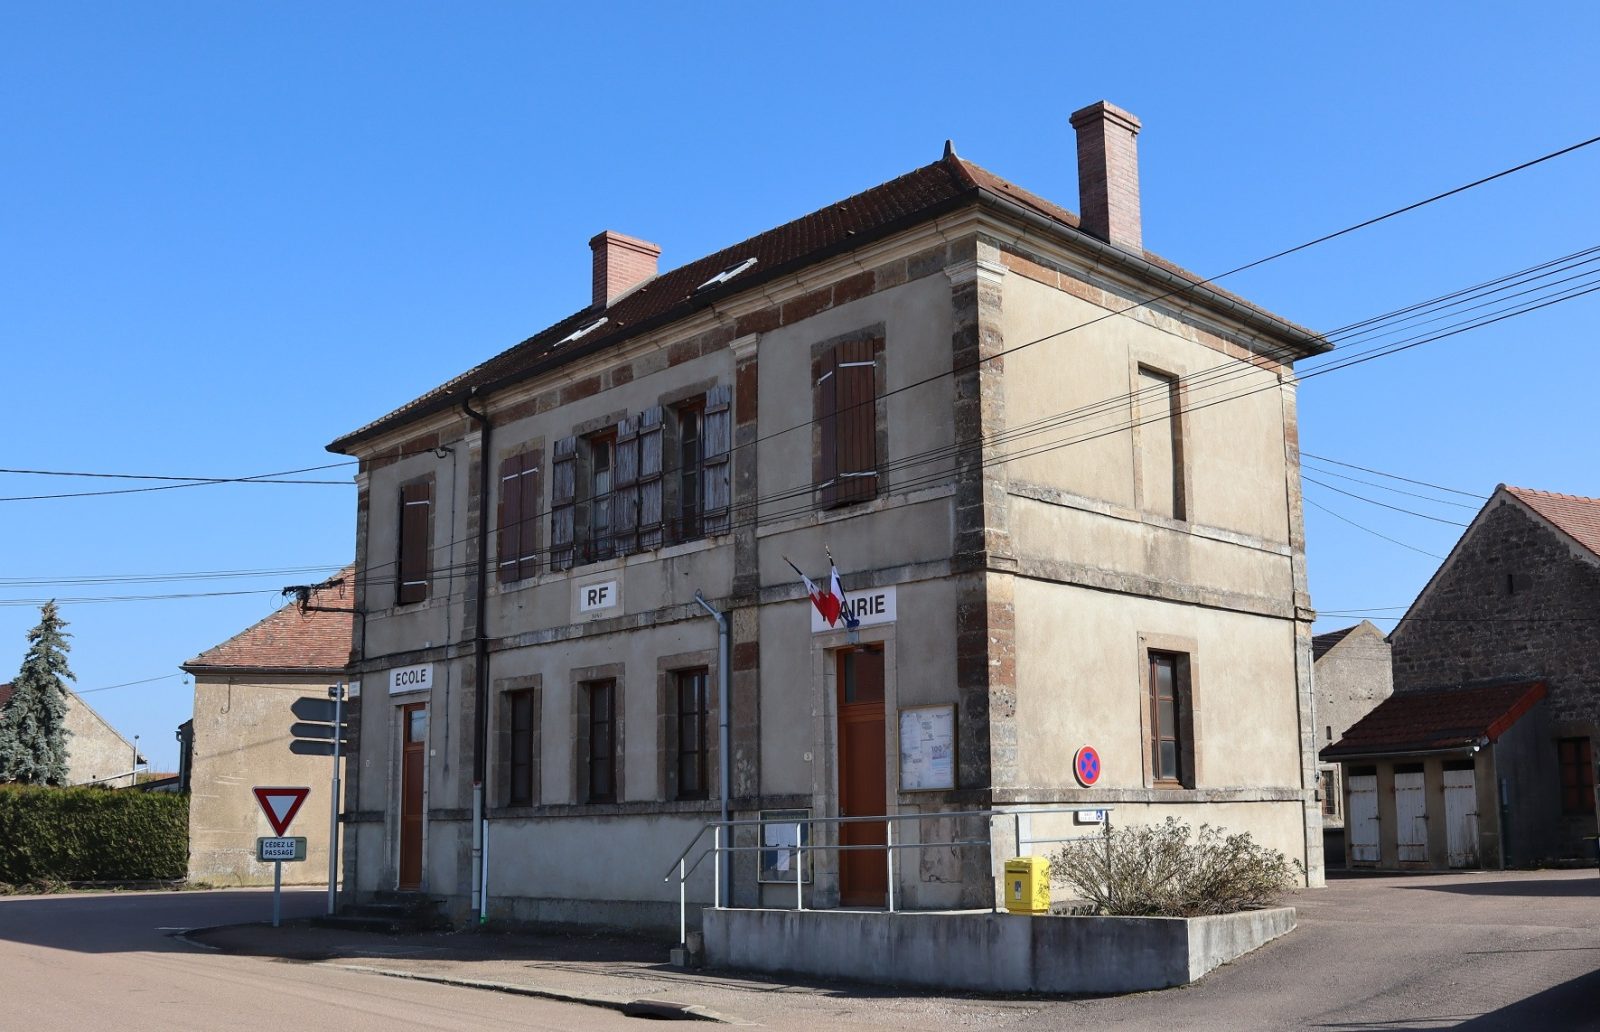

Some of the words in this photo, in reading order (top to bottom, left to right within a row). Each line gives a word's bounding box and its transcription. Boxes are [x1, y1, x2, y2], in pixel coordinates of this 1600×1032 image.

[587, 586, 609, 606] RF
[822, 594, 886, 622] AIRIE
[395, 669, 426, 686] ECOLE
